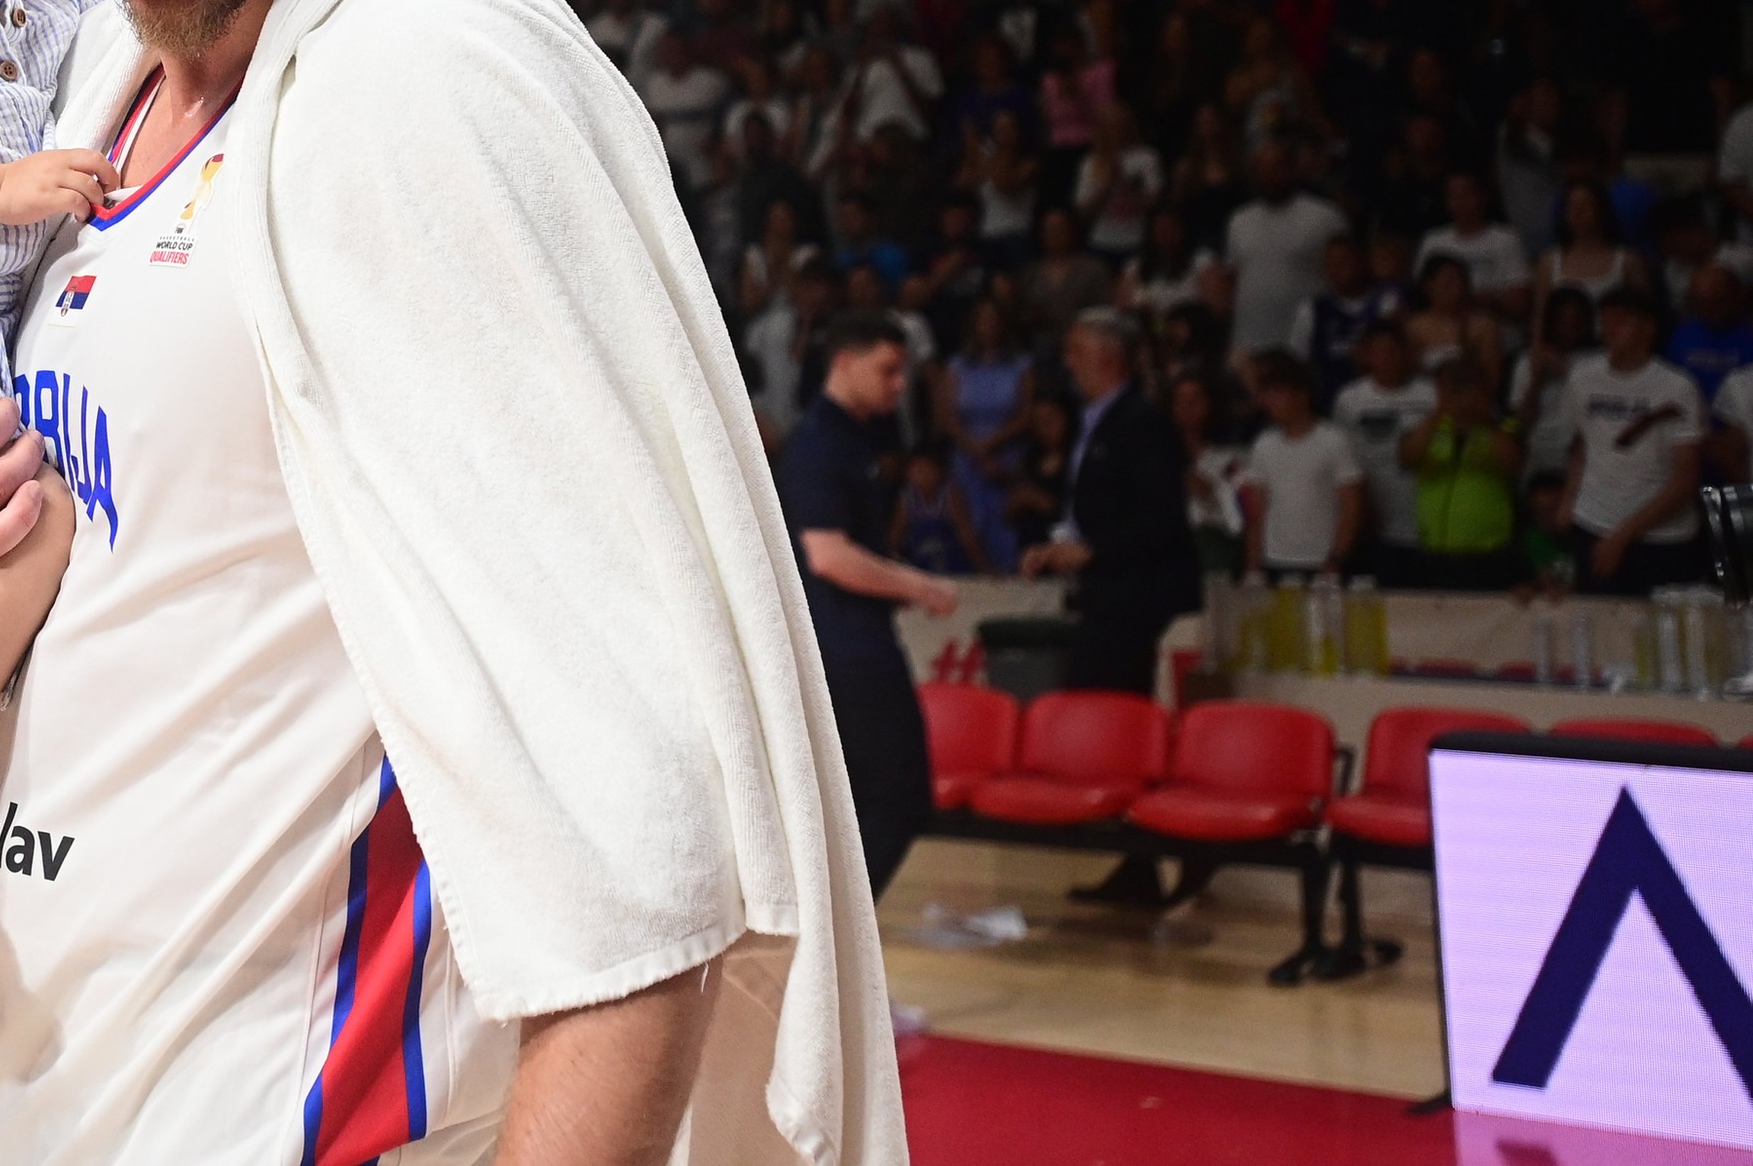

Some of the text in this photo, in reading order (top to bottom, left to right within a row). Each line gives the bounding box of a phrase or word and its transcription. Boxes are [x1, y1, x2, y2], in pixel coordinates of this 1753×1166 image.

[156, 241, 193, 250] WORLD CUP
[149, 250, 189, 264] QUALIFIERS
